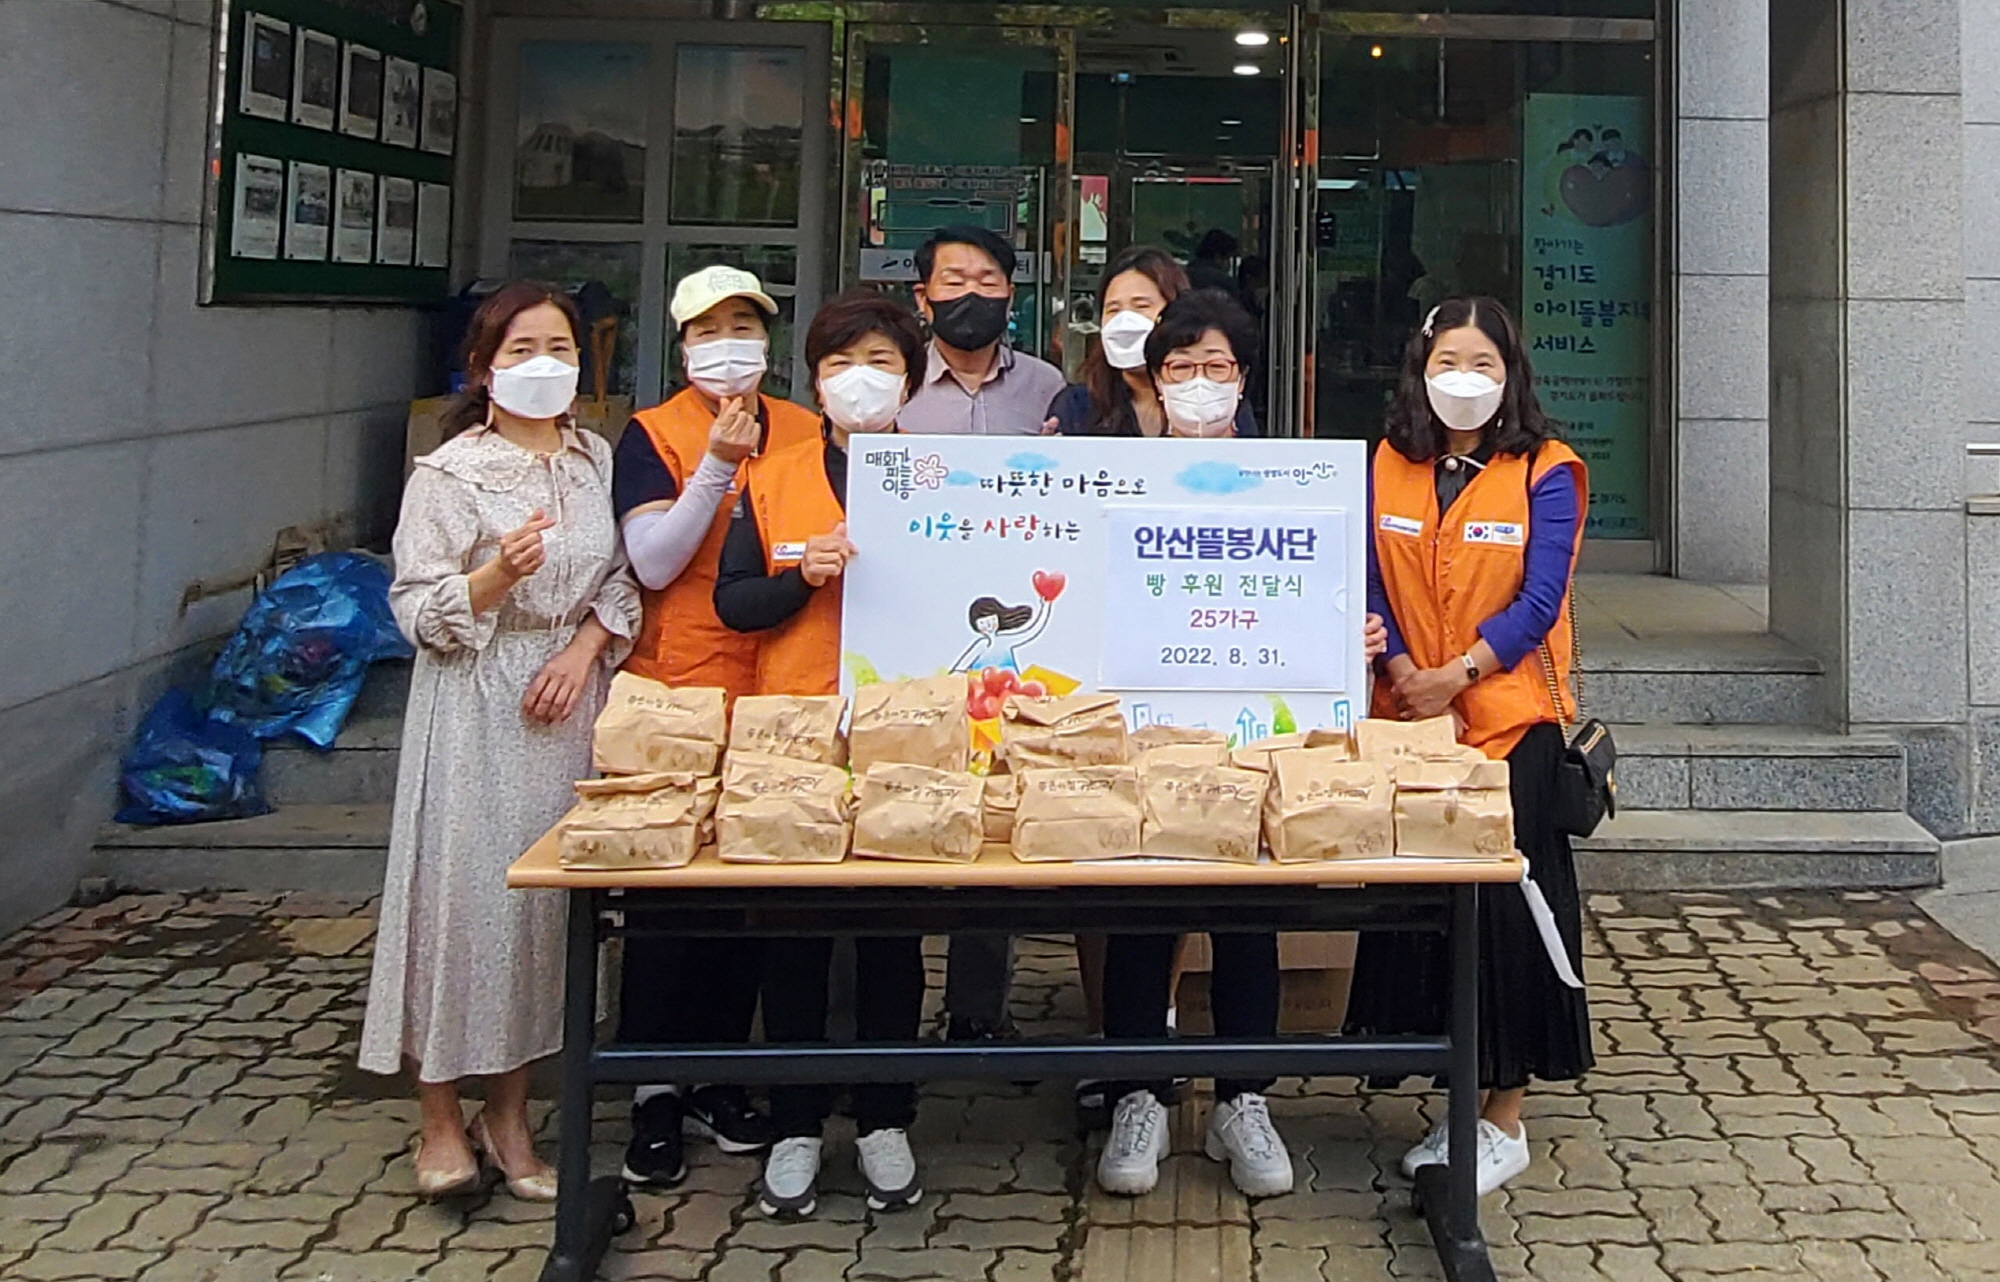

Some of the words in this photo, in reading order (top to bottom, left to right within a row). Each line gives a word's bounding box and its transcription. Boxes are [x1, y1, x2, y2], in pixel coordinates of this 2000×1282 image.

[1533, 264, 1597, 291] 경기도
[1532, 334, 1597, 354] 서비스
[865, 446, 912, 467] 매화가
[885, 463, 913, 478] 피는
[1292, 461, 1335, 487] 안산
[882, 478, 917, 501] 이동
[980, 470, 1054, 498] 따뜻한
[1062, 469, 1148, 498] 마음으로
[909, 512, 975, 541] 이웃을
[983, 514, 1081, 541] 사랑하는
[1134, 526, 1318, 561] 안산뜰봉사단
[1146, 573, 1167, 597] 빵
[1181, 573, 1223, 597] 후원
[1238, 574, 1303, 598] 전달식
[1190, 608, 1259, 630] 25가구
[1161, 647, 1217, 666] 2022.
[1229, 647, 1248, 667] 8.
[1258, 648, 1286, 667] 31.
